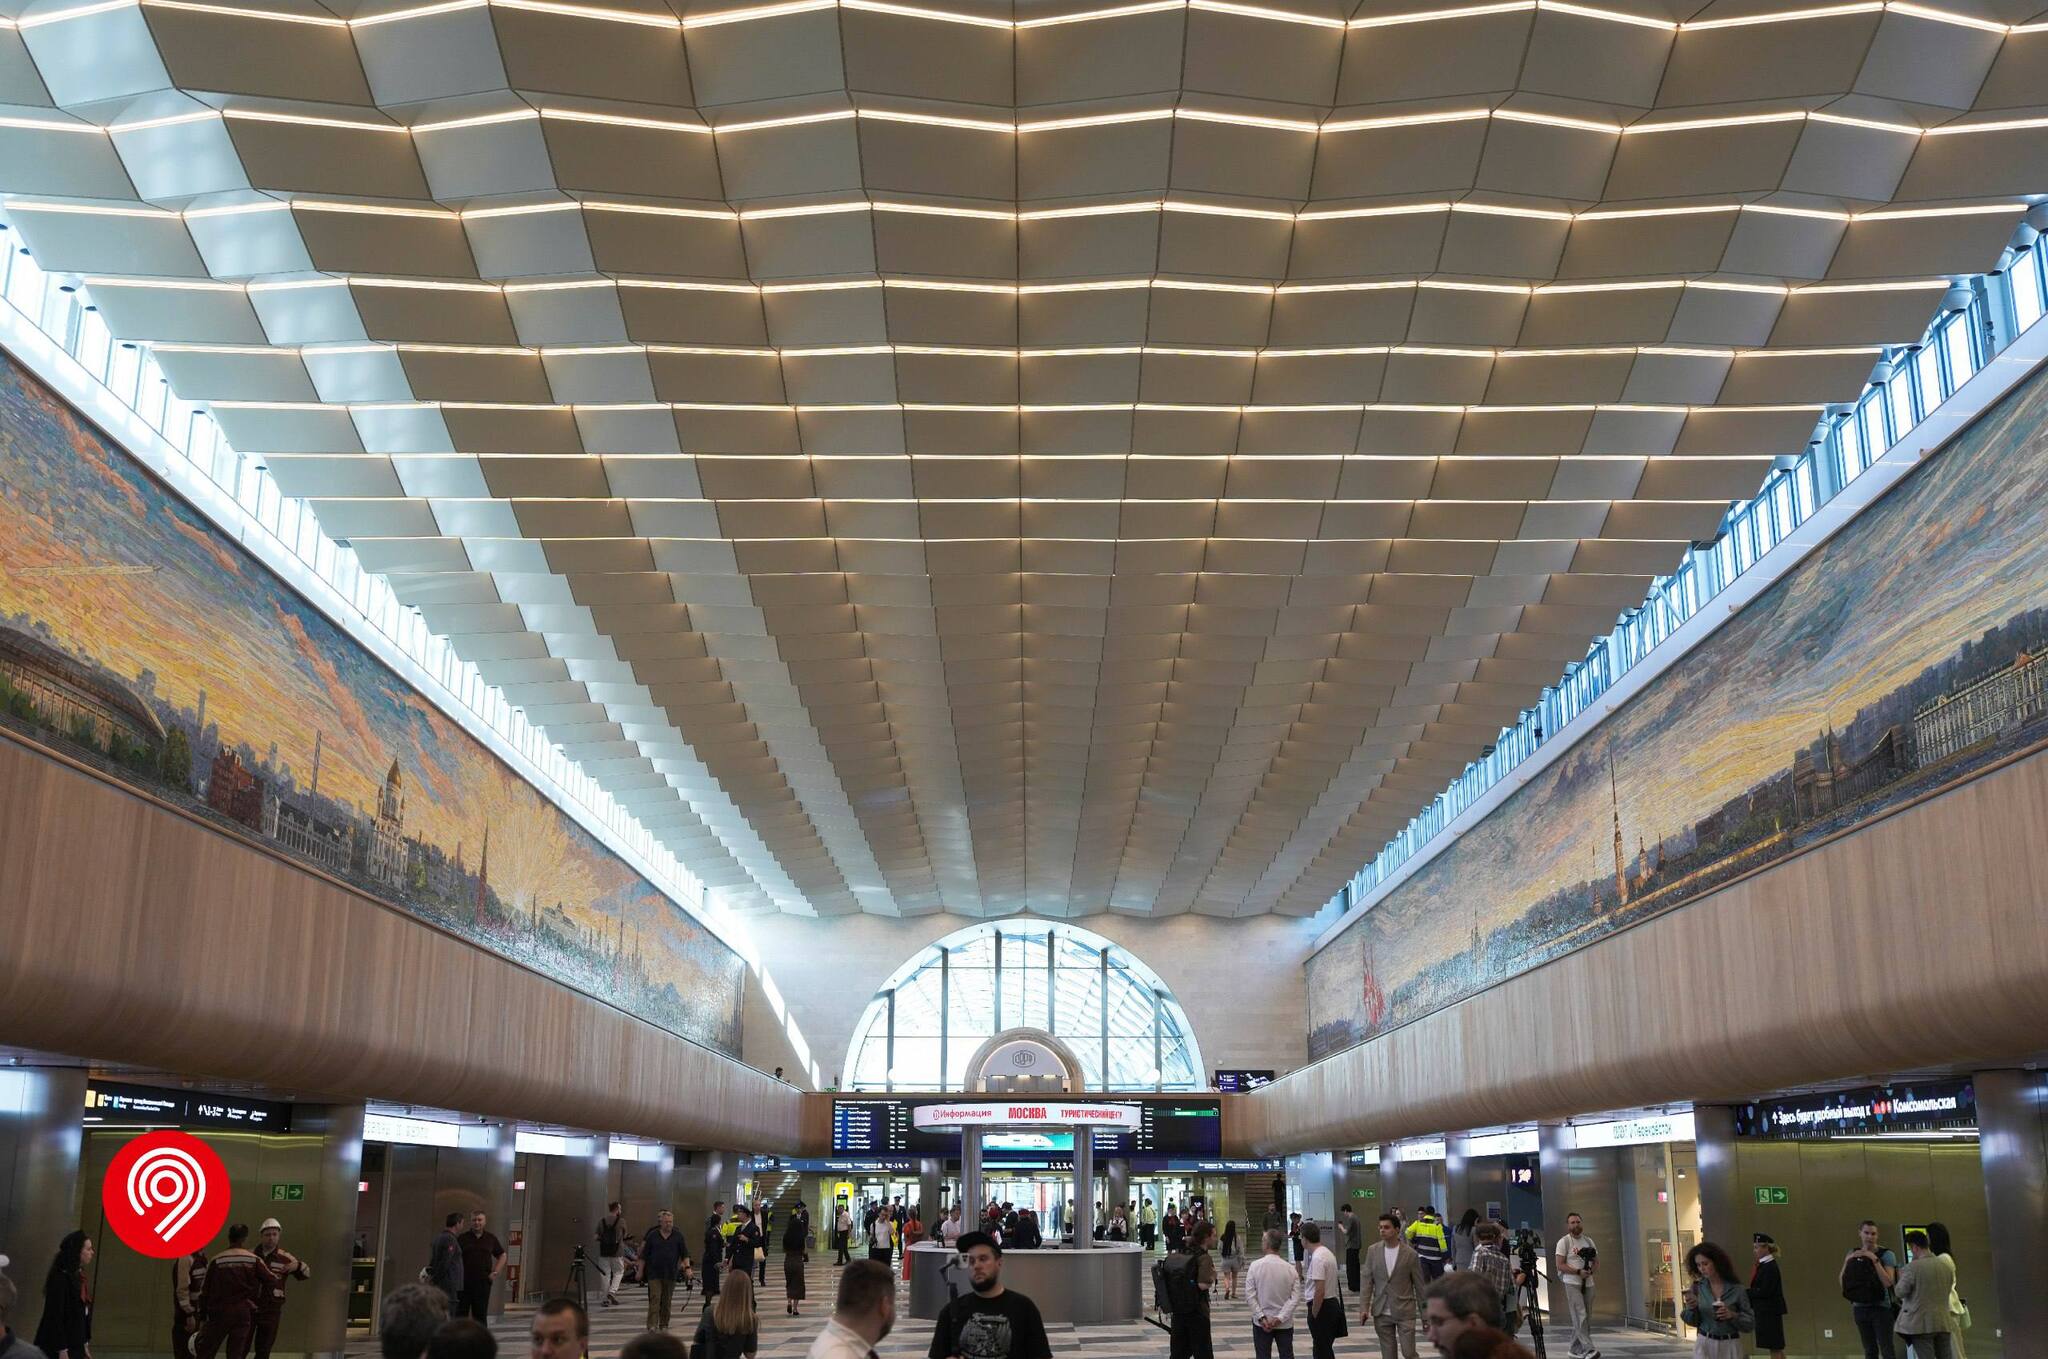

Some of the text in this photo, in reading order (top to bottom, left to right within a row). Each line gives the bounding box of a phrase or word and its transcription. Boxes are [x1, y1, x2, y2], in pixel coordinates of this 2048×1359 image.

[940, 1109, 992, 1120] Информация
[1008, 1107, 1047, 1119] МОСКВА
[1778, 1110, 1796, 1125] Здесь
[1796, 1108, 1813, 1125] будет
[1813, 1105, 1843, 1124] удобный
[1843, 1105, 1866, 1119] выход
[1893, 1097, 1957, 1114] Комсомольская
